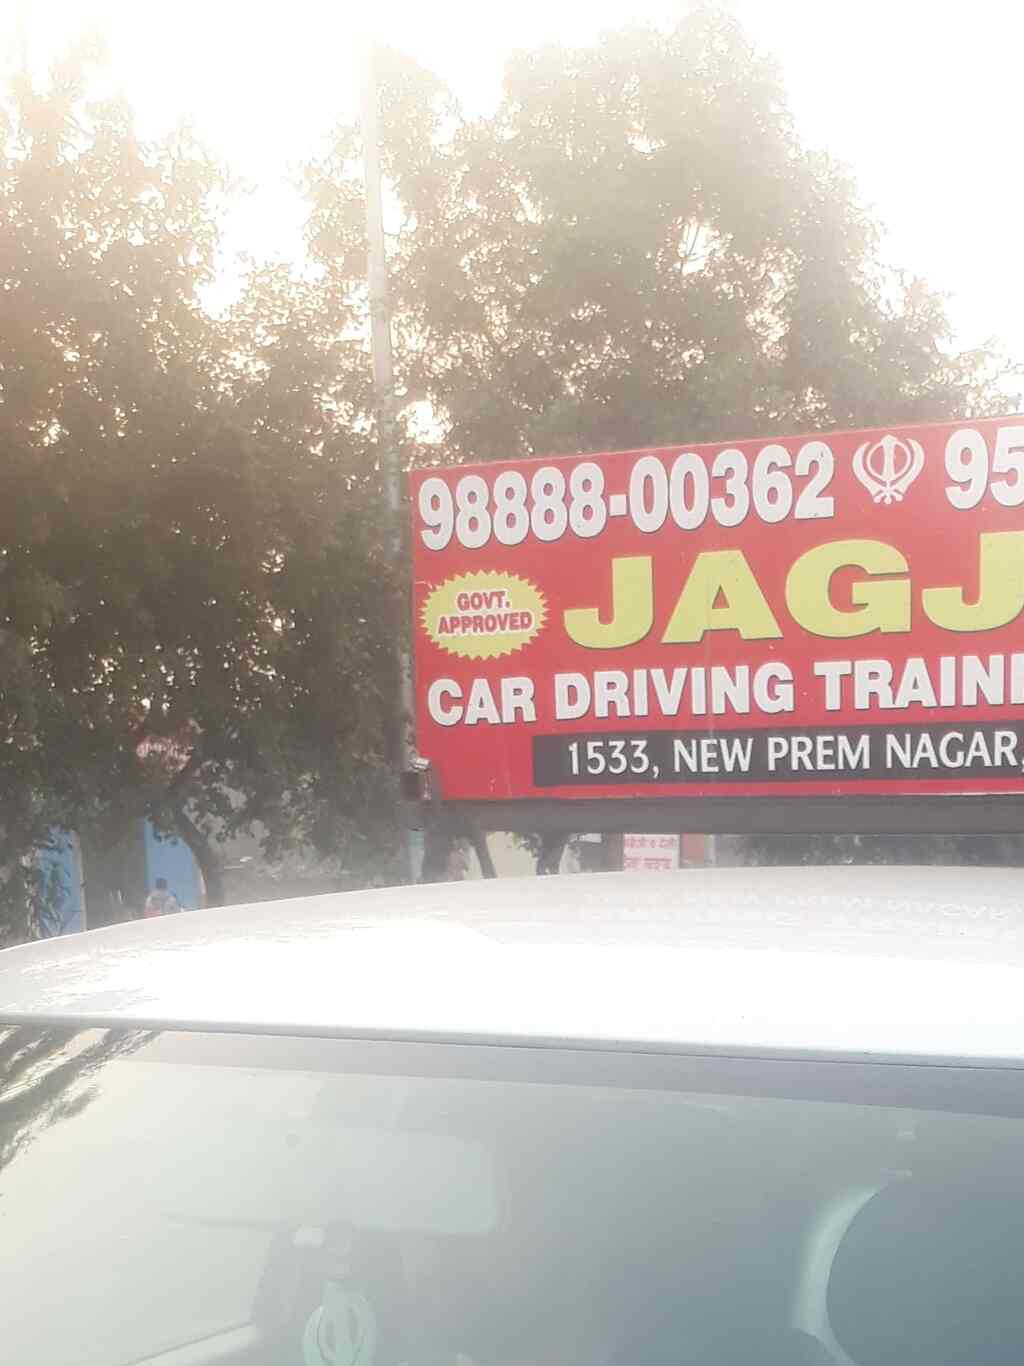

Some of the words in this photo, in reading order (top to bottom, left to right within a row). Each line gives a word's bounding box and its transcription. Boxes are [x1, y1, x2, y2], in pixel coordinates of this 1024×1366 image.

[419, 441, 835, 550] 98888-00362
[456, 590, 510, 611] GOVT.
[437, 611, 533, 634] APPROVED
[427, 676, 536, 726] CAR
[554, 661, 795, 721] DRIVING
[567, 739, 660, 777] 1533,
[673, 737, 754, 774] NEW
[766, 735, 872, 772] PREM
